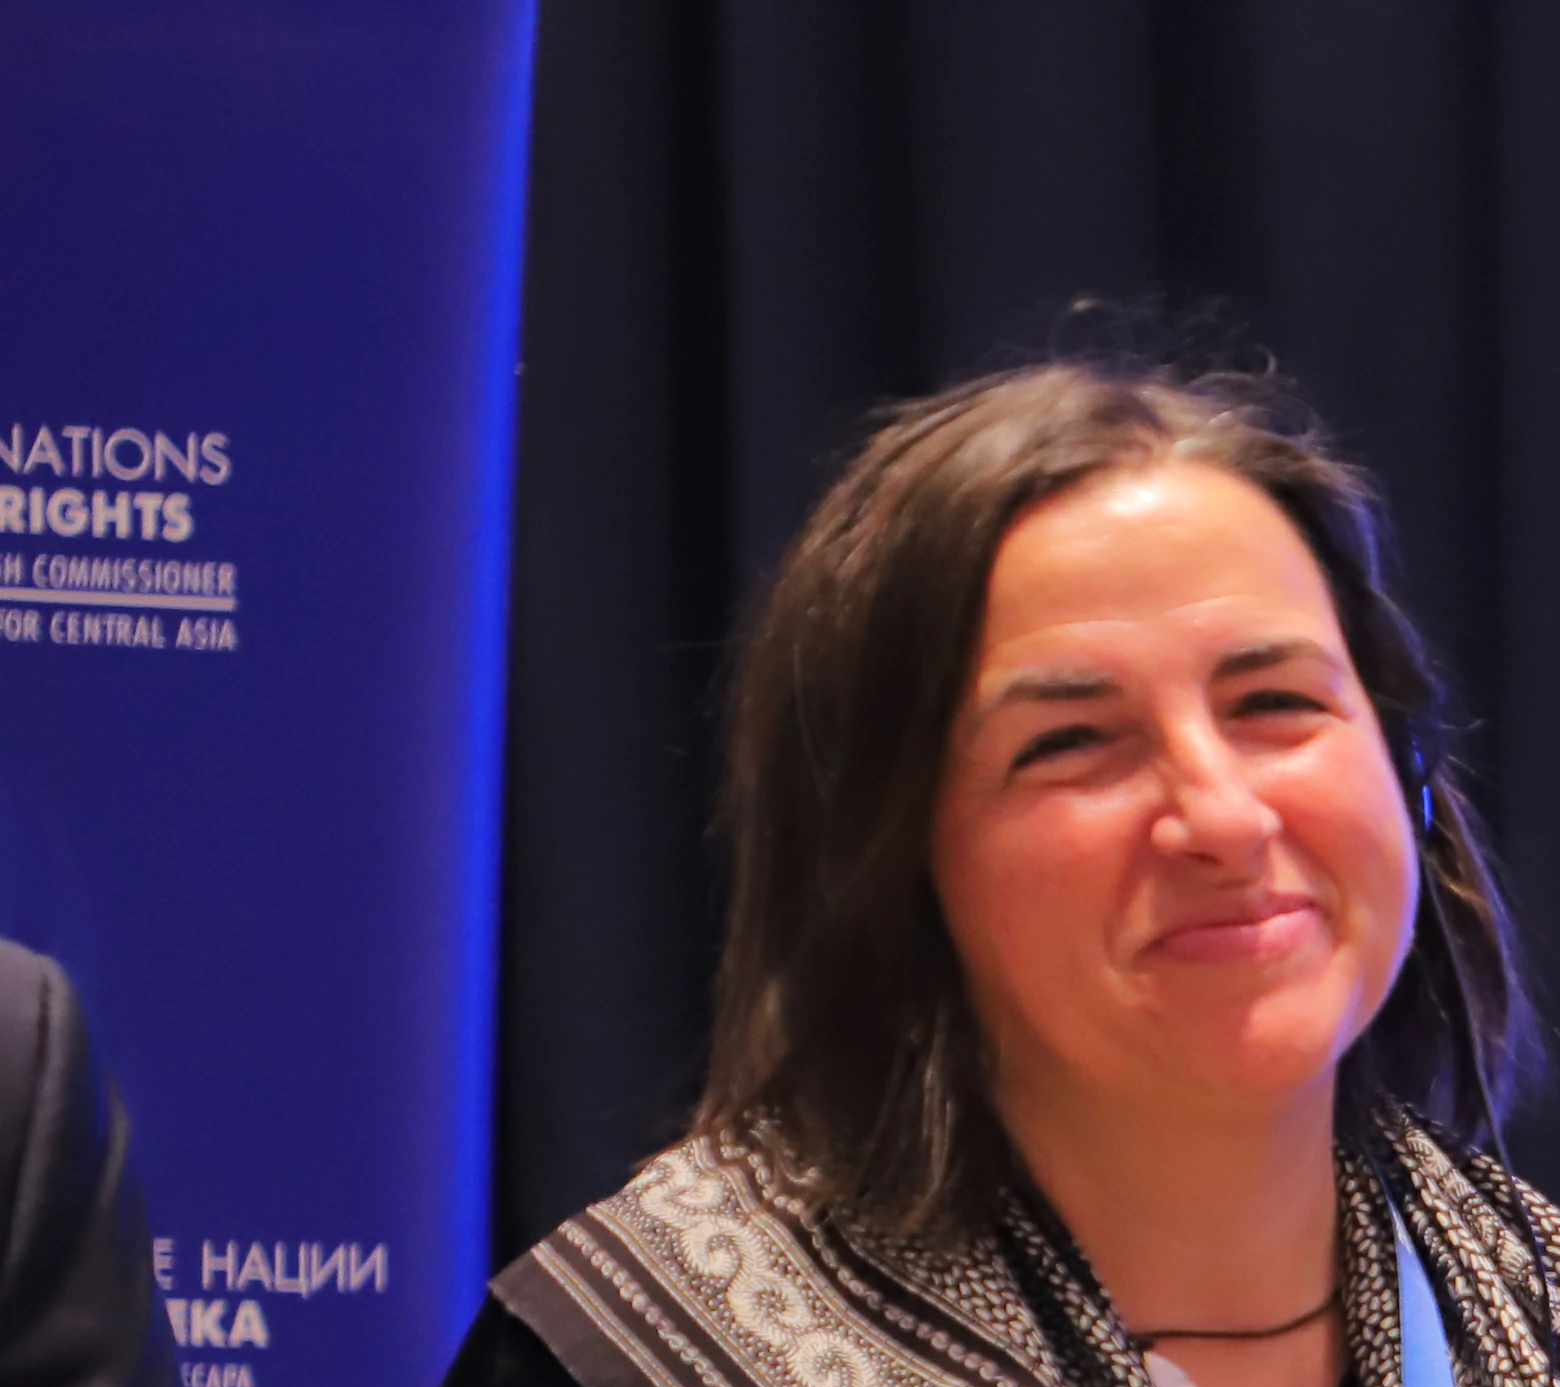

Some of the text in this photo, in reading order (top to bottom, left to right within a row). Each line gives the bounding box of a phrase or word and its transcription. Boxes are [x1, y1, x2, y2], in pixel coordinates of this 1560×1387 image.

[0, 423, 232, 486] NATIONS
[0, 484, 194, 543] RIGHTS
[33, 552, 237, 596] COMMISSIONER
[50, 610, 165, 648] CENTRAL
[175, 615, 237, 652] ASIA
[202, 1239, 390, 1298] НАЦИИ
